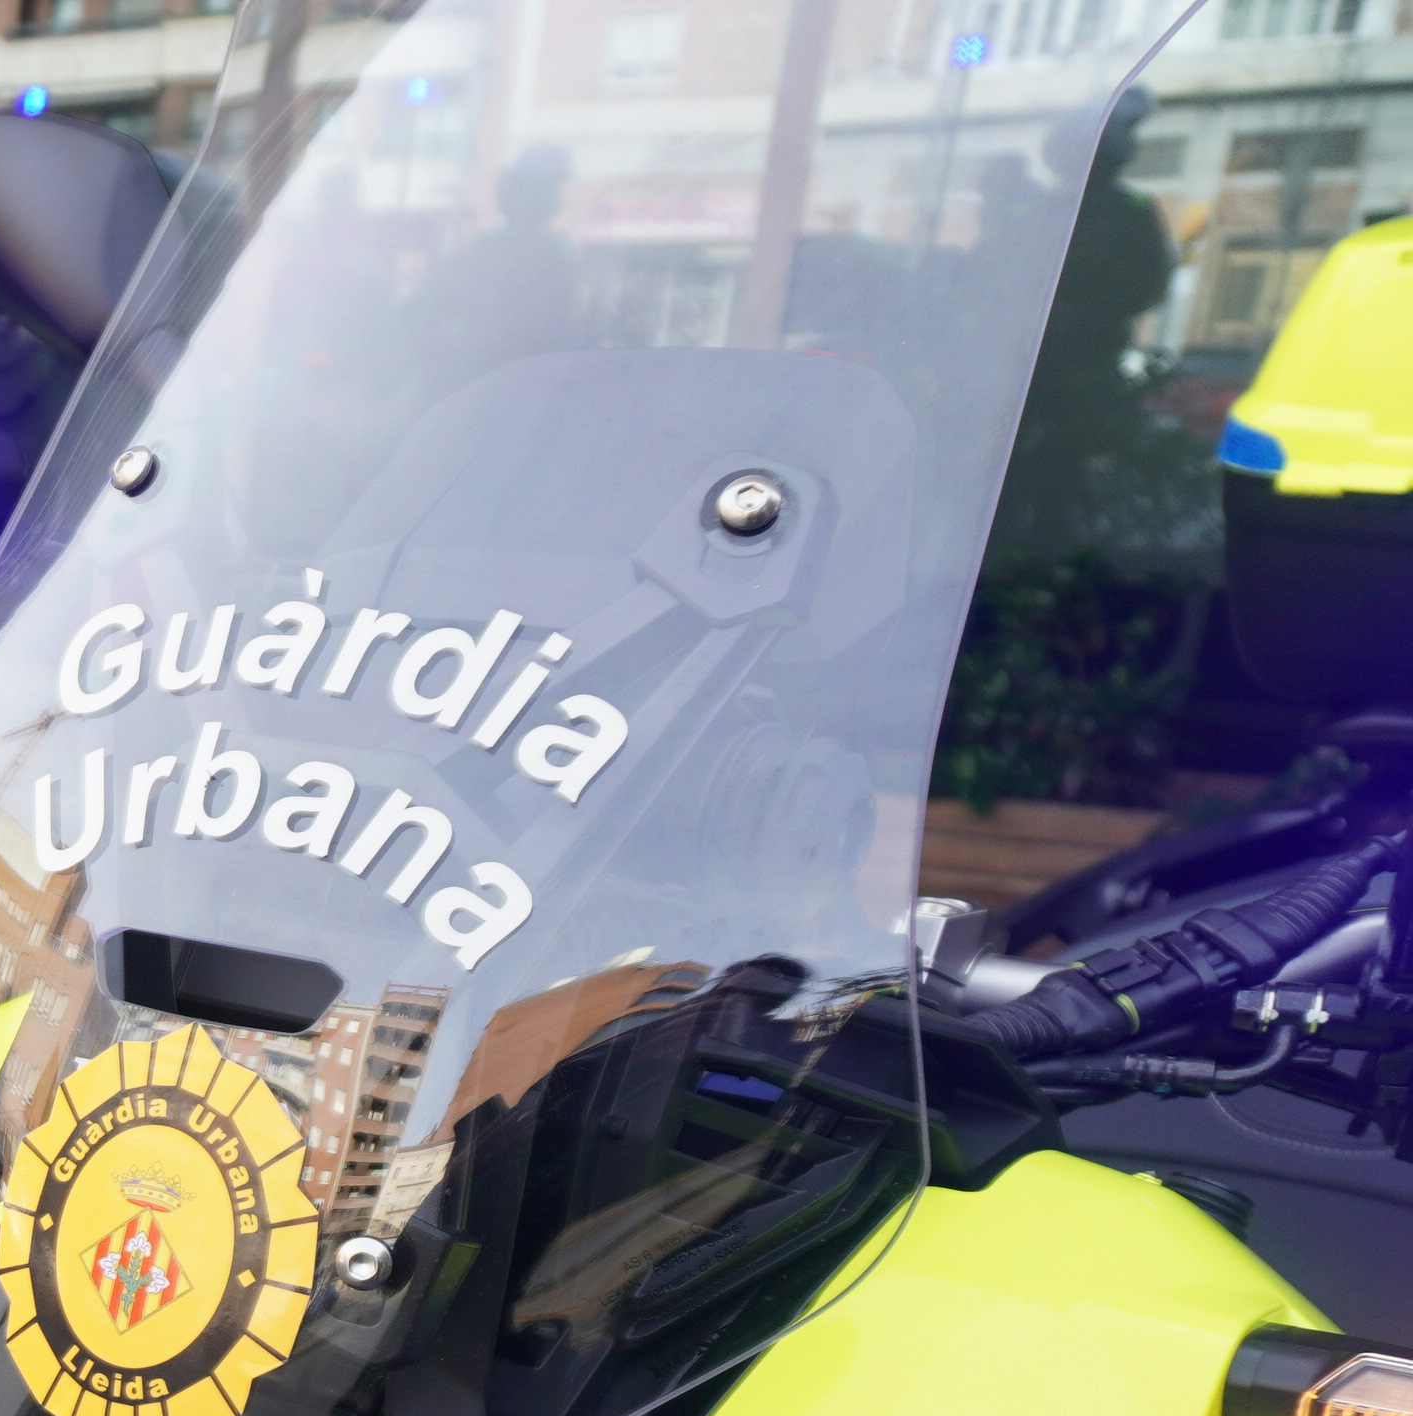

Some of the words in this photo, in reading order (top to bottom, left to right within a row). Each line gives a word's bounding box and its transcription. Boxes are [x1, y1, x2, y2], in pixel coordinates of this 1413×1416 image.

[59, 567, 629, 804] Guàrdia
[34, 720, 533, 971] Urbana
[53, 1093, 168, 1183] Guàrdia
[188, 1104, 260, 1235] Urbana
[61, 1344, 170, 1400] Lleida
